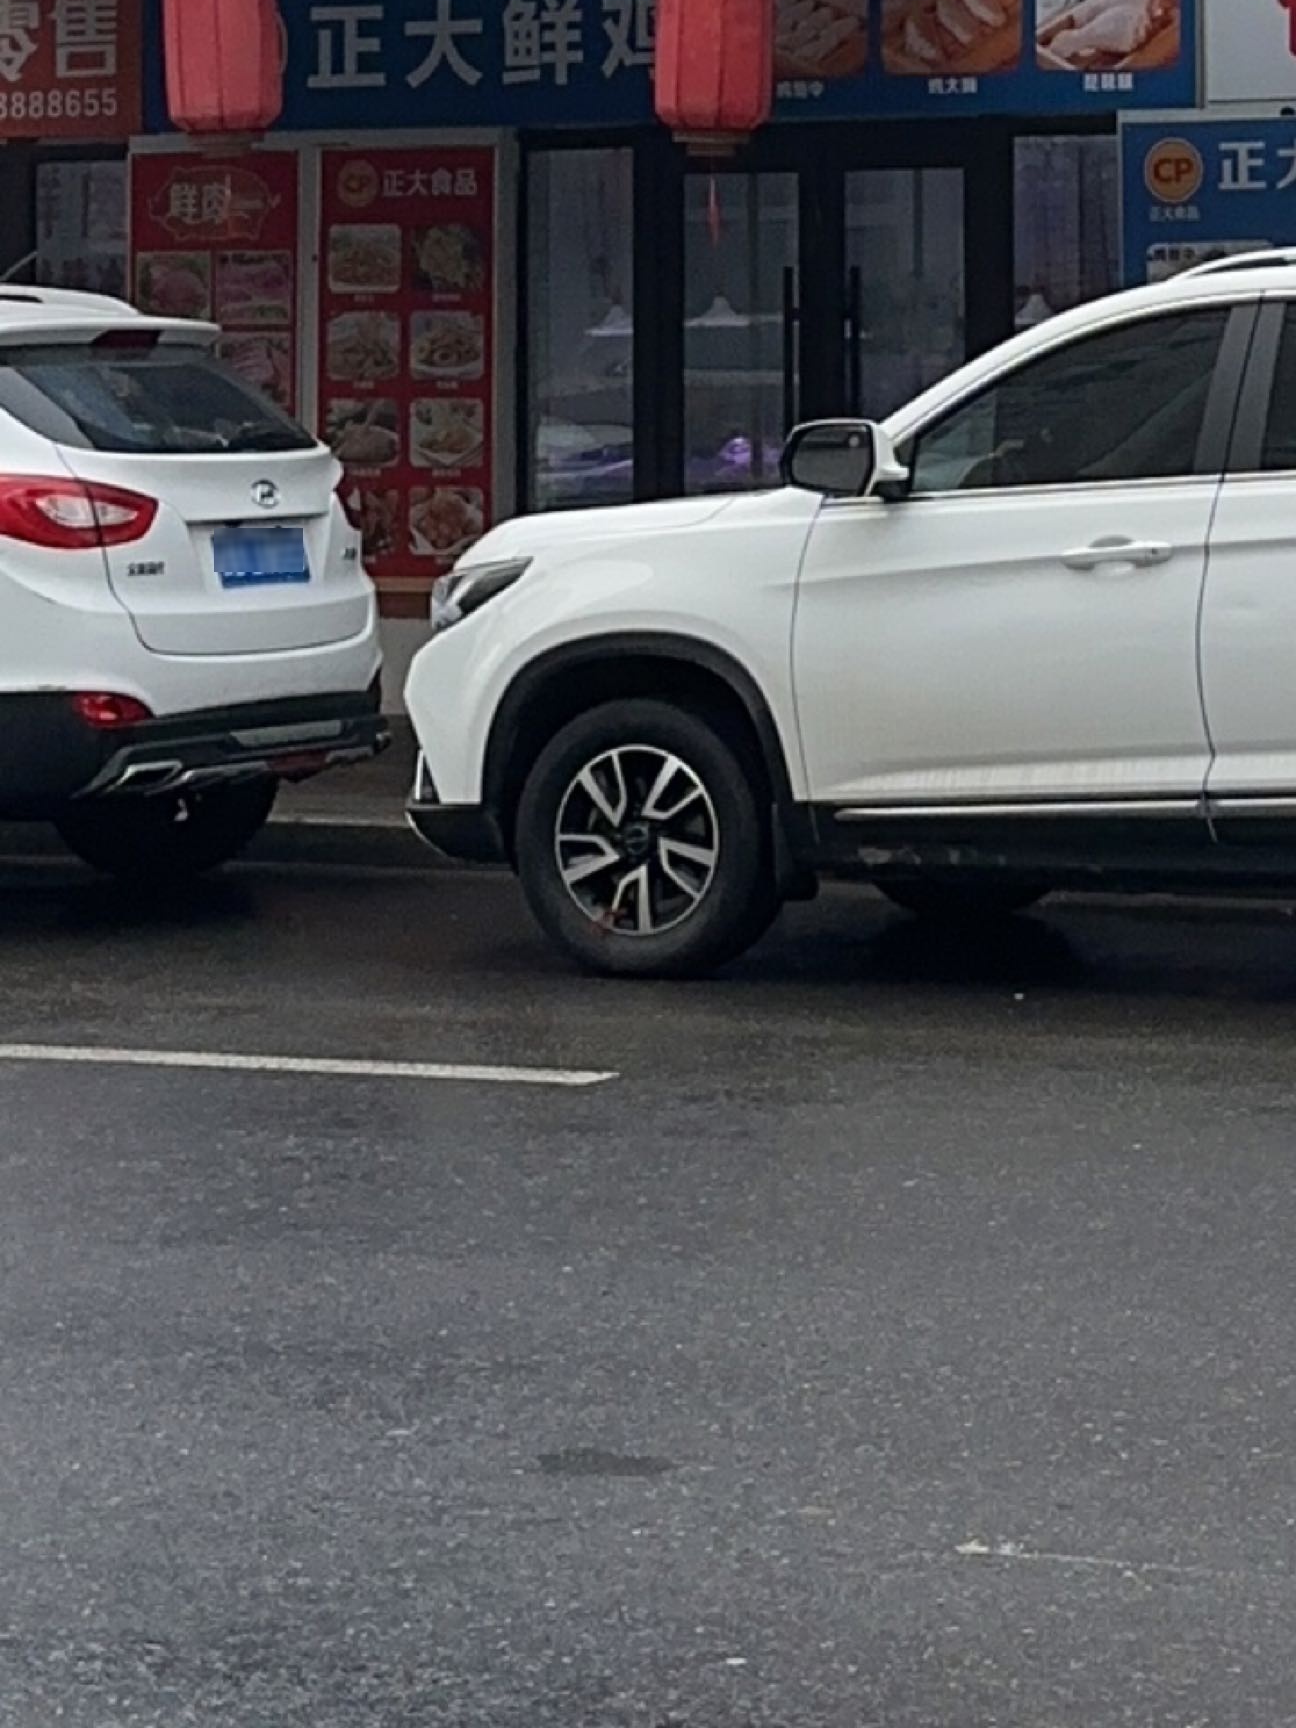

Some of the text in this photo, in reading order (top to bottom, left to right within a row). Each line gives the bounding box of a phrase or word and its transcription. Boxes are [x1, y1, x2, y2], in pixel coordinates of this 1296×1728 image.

[382, 168, 478, 198] 正大食品
[1152, 158, 1195, 184] CP
